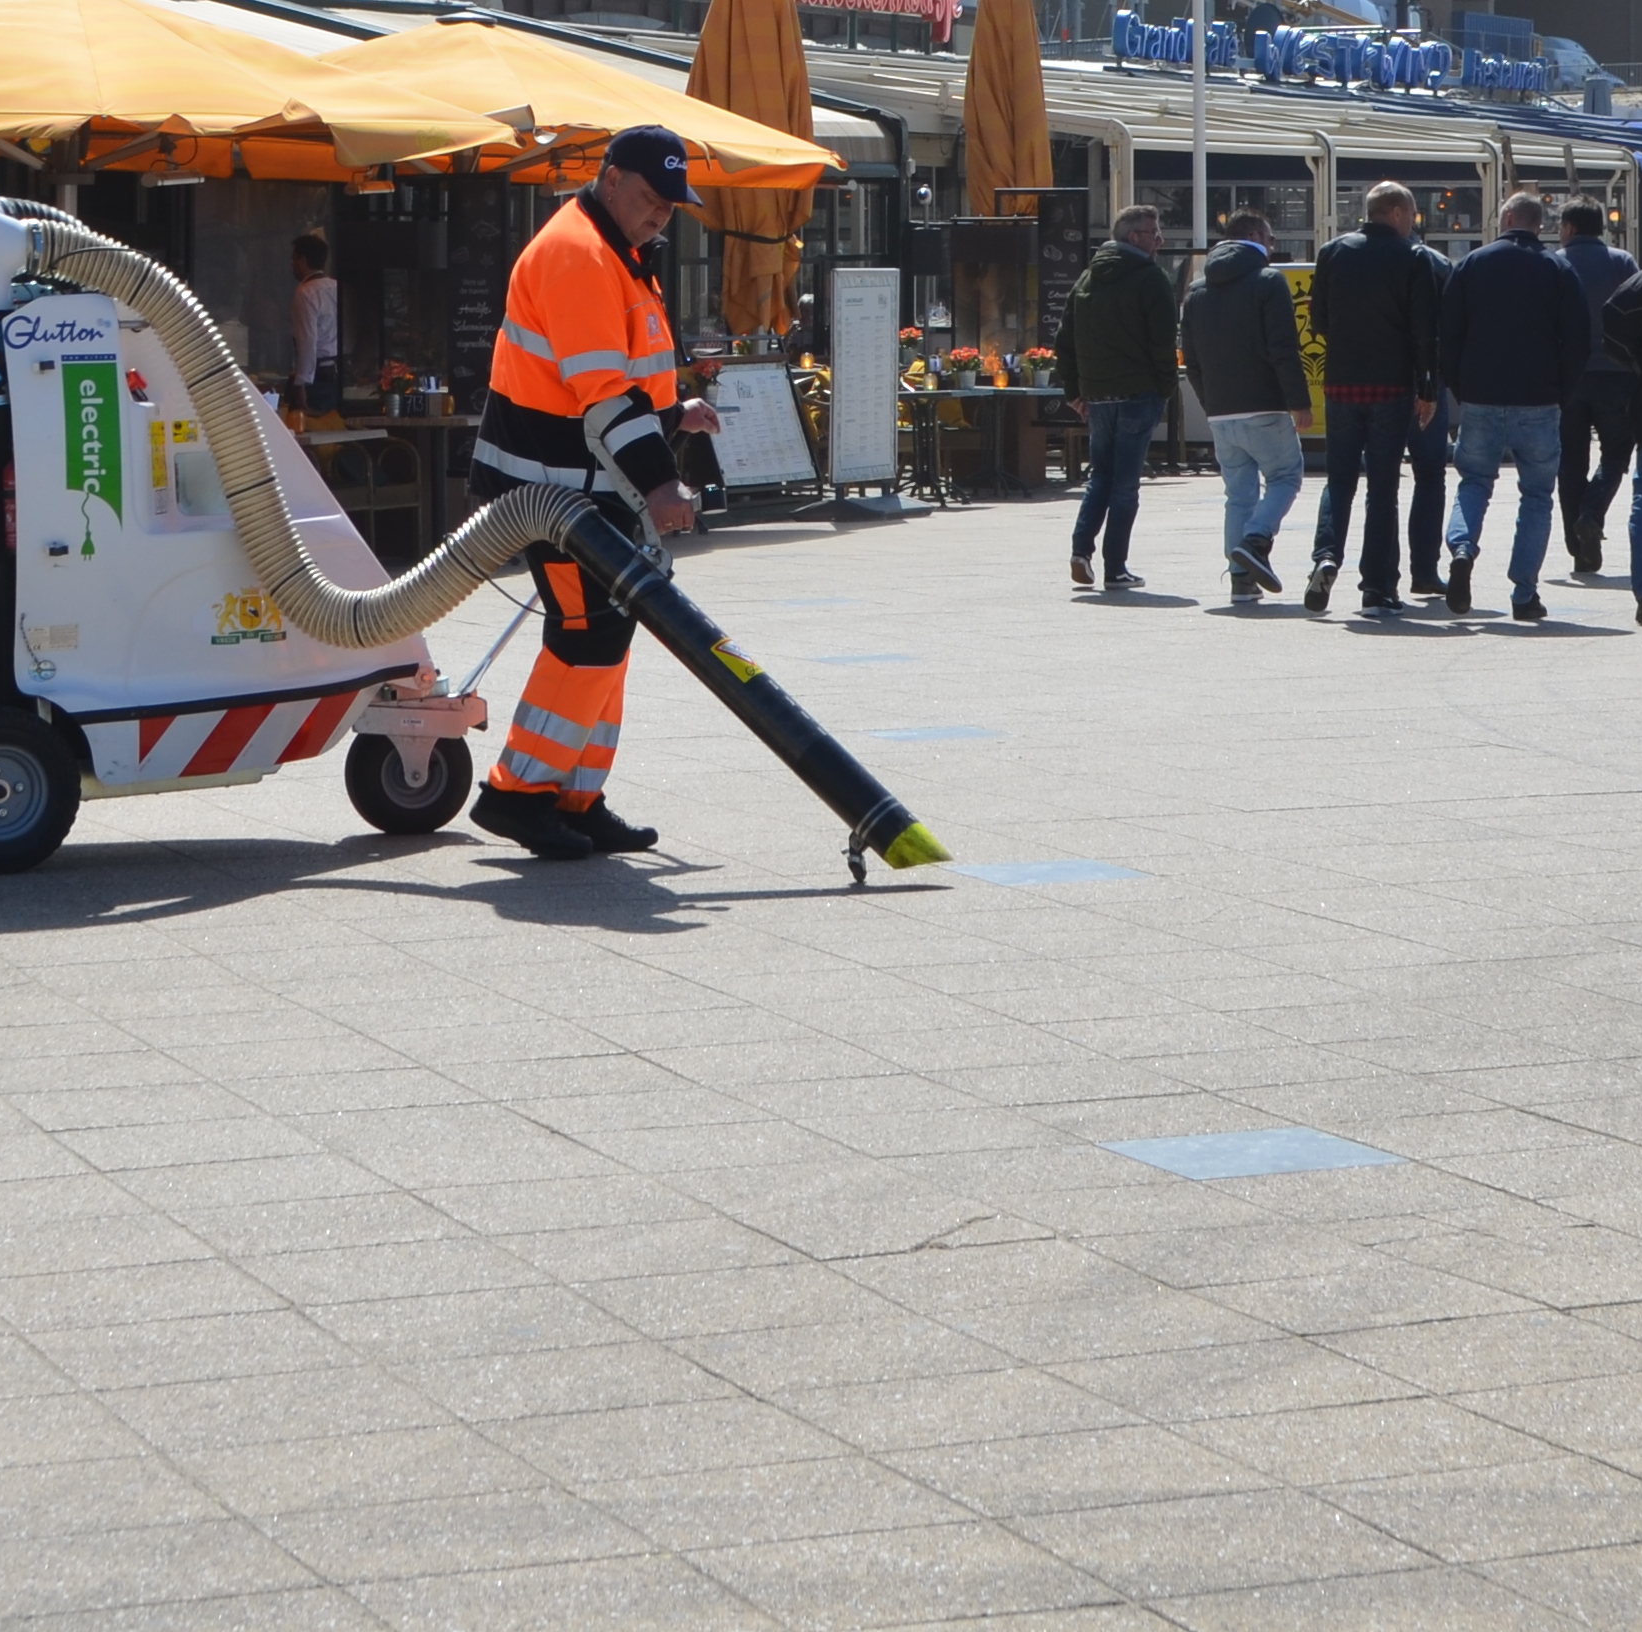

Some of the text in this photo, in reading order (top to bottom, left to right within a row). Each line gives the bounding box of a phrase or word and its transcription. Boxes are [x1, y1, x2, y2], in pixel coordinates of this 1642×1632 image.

[1114, 9, 1195, 62] Grand
[4, 315, 105, 349] Glutton
[79, 379, 107, 493] electric
